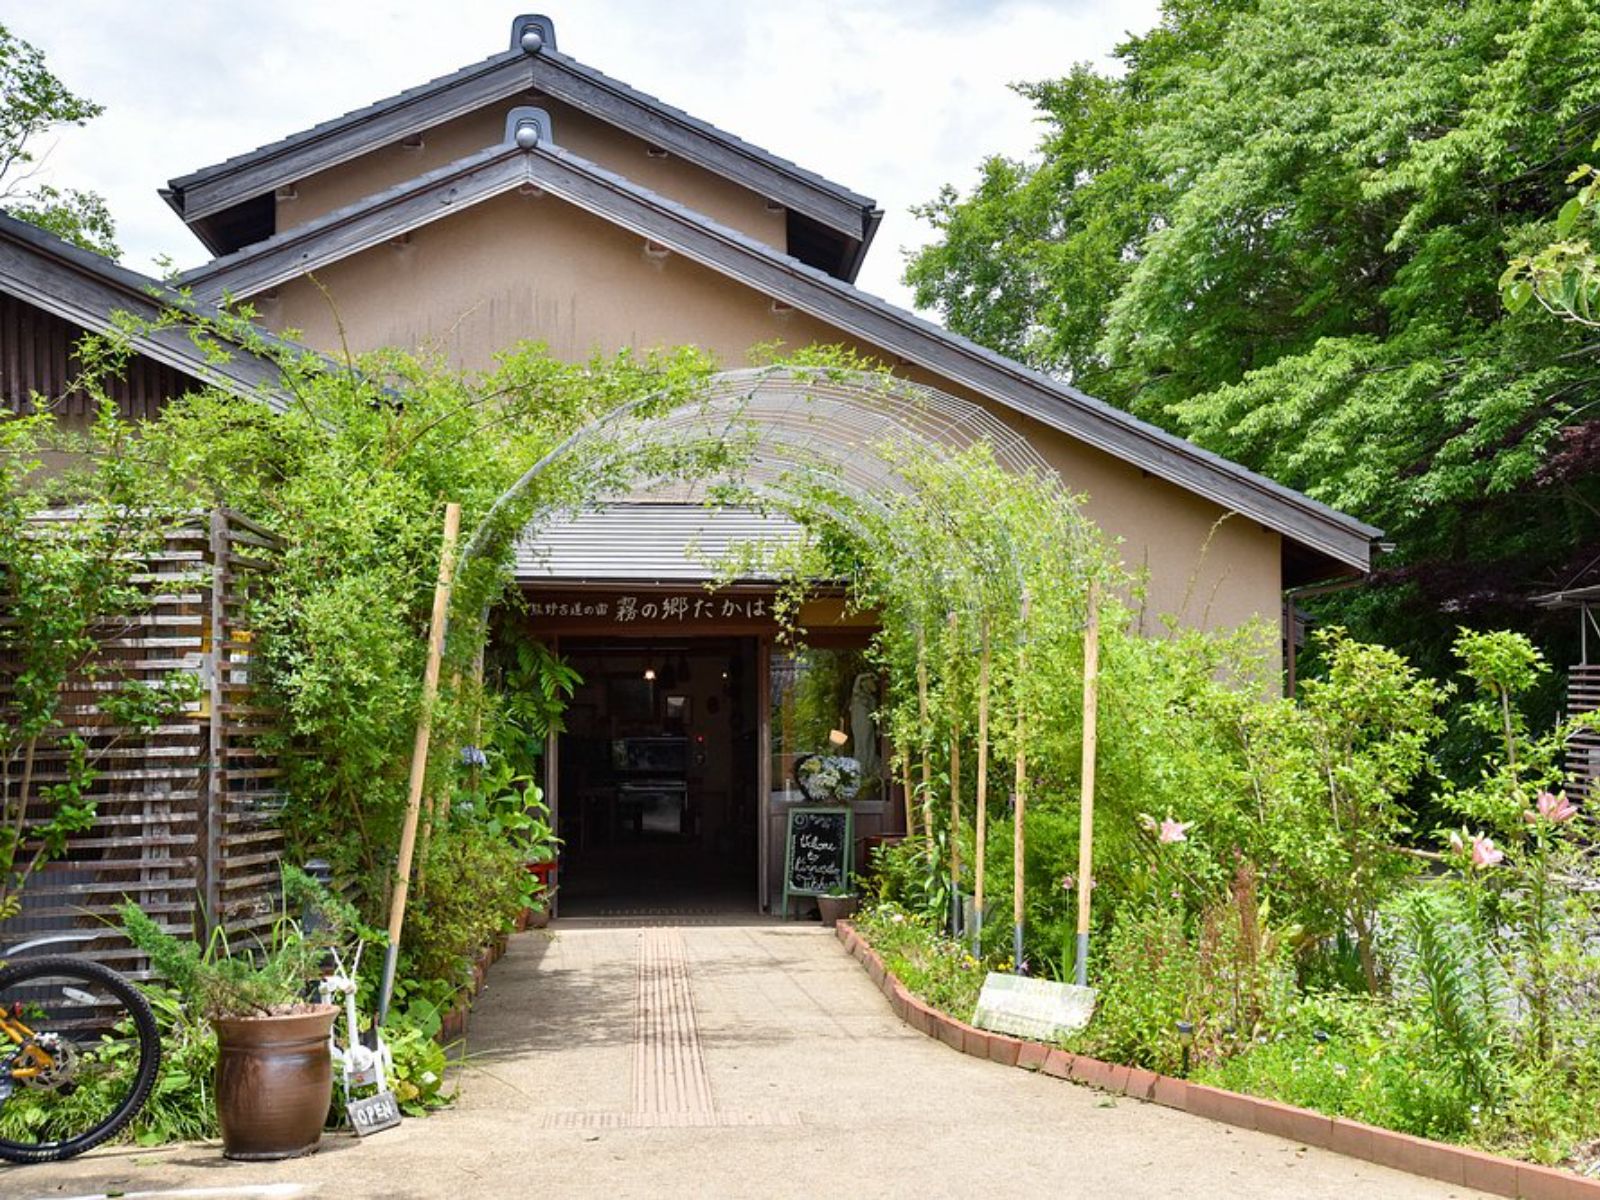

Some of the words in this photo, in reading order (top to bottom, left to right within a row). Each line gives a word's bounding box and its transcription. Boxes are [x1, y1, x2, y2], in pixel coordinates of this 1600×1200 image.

[615, 597, 788, 621] 霧の郷たかは
[357, 1100, 393, 1125] OPEN
